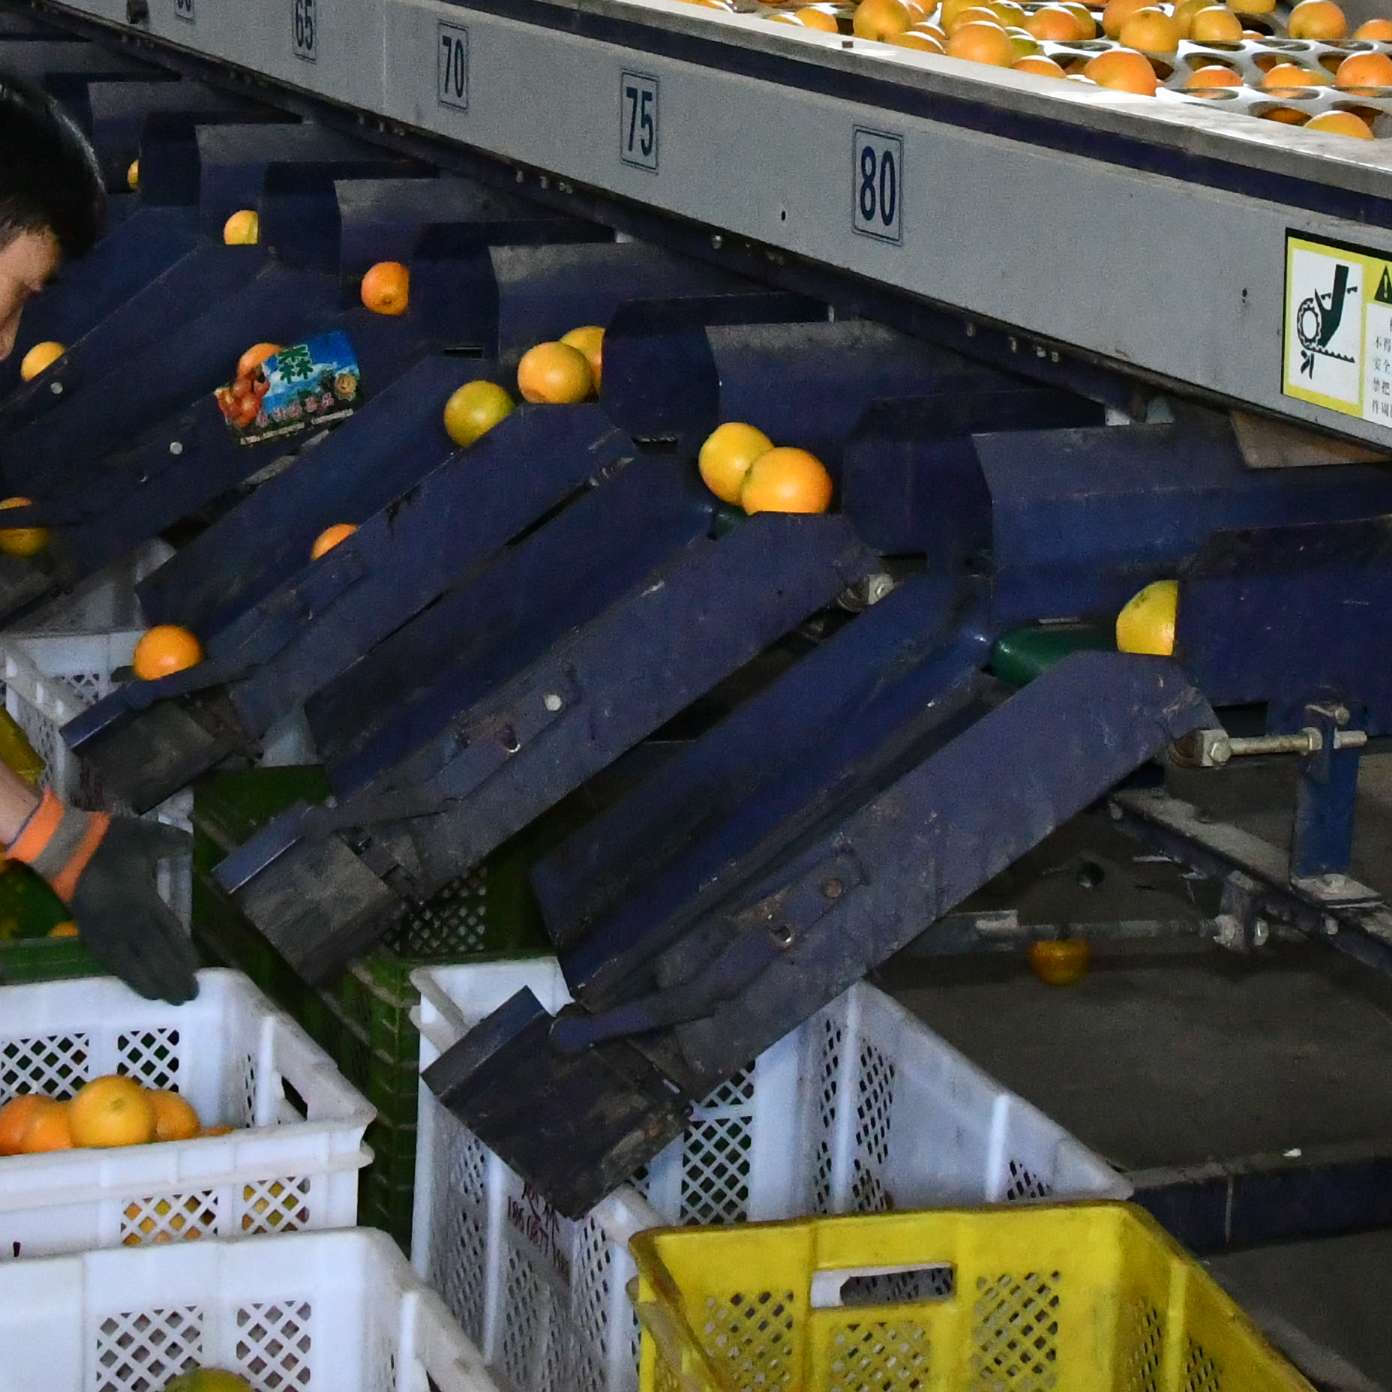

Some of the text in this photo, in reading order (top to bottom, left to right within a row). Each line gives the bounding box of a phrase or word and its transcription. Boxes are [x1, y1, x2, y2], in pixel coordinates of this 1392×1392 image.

[442, 35, 465, 99] 70
[625, 86, 654, 157] 75
[859, 145, 897, 227] 80
